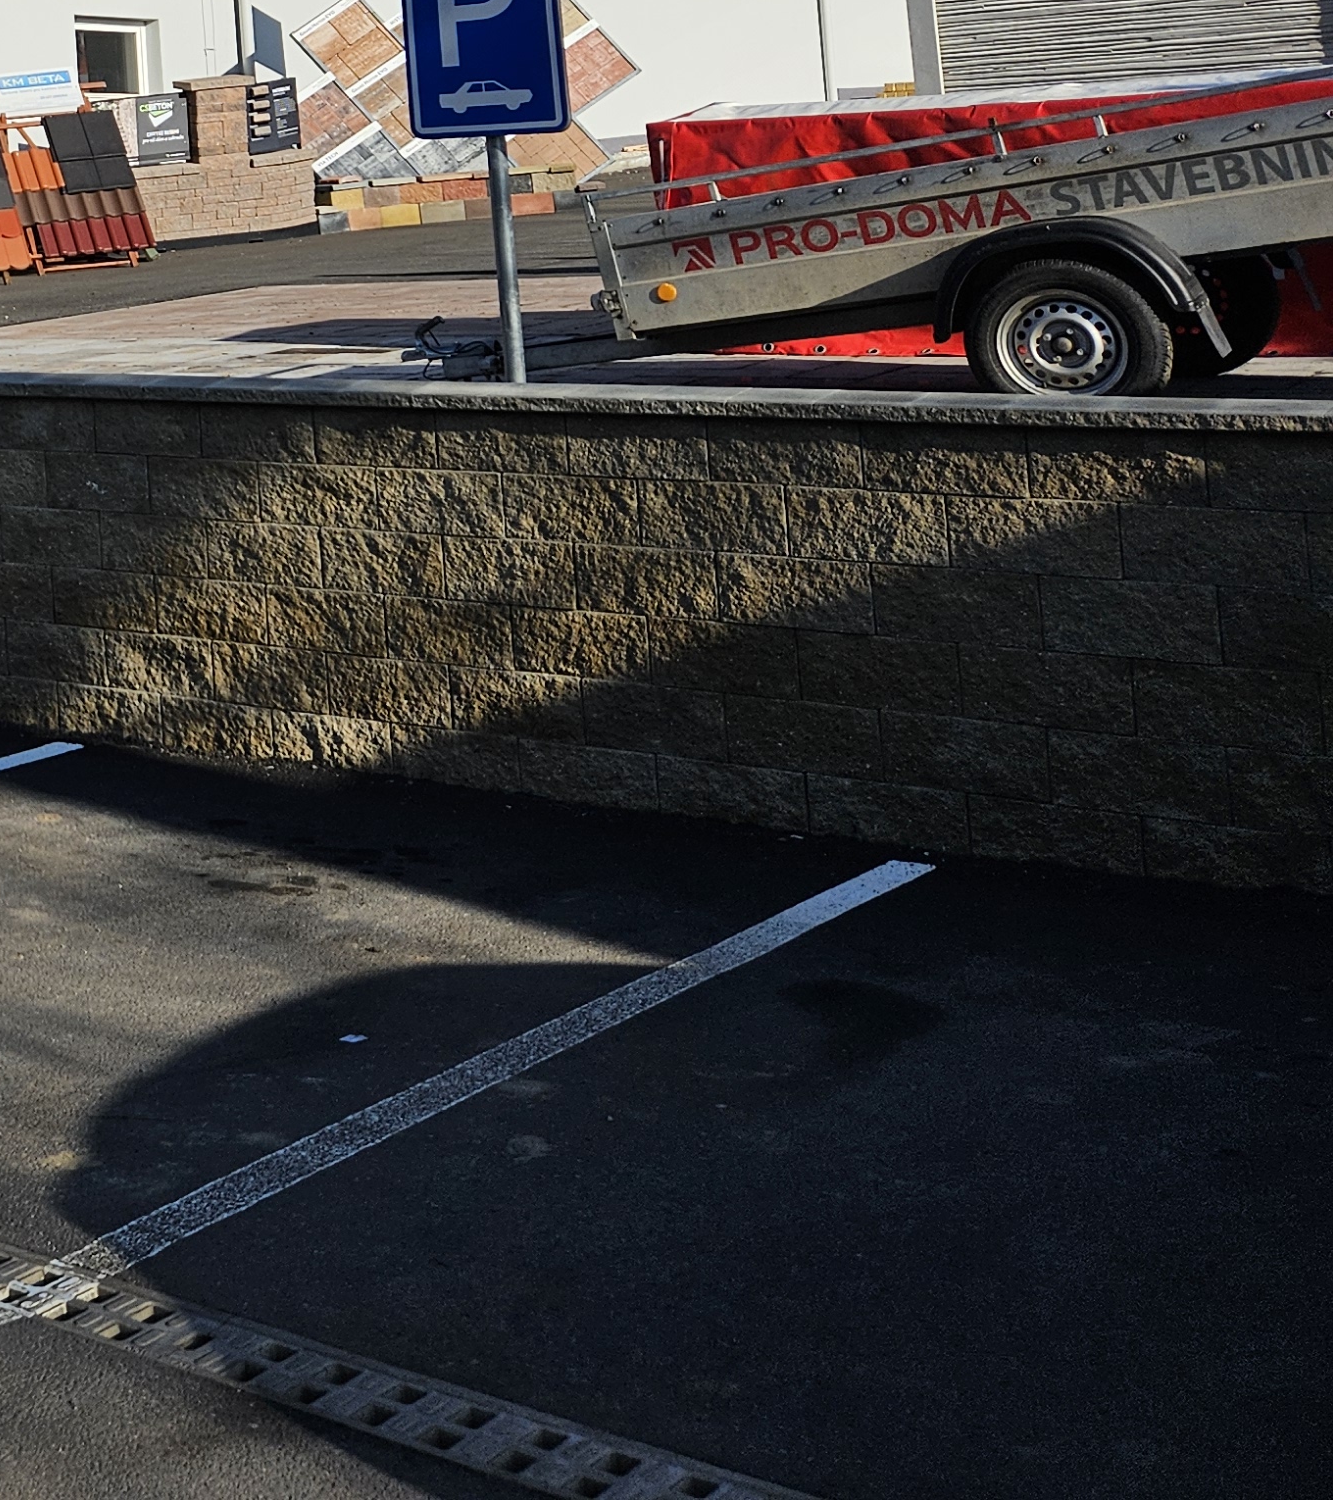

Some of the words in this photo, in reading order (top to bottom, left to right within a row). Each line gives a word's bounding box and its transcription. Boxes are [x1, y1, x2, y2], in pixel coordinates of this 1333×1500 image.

[2, 77, 24, 87] KM
[27, 74, 65, 85] BETA
[730, 188, 1033, 266] PRO-DOMA
